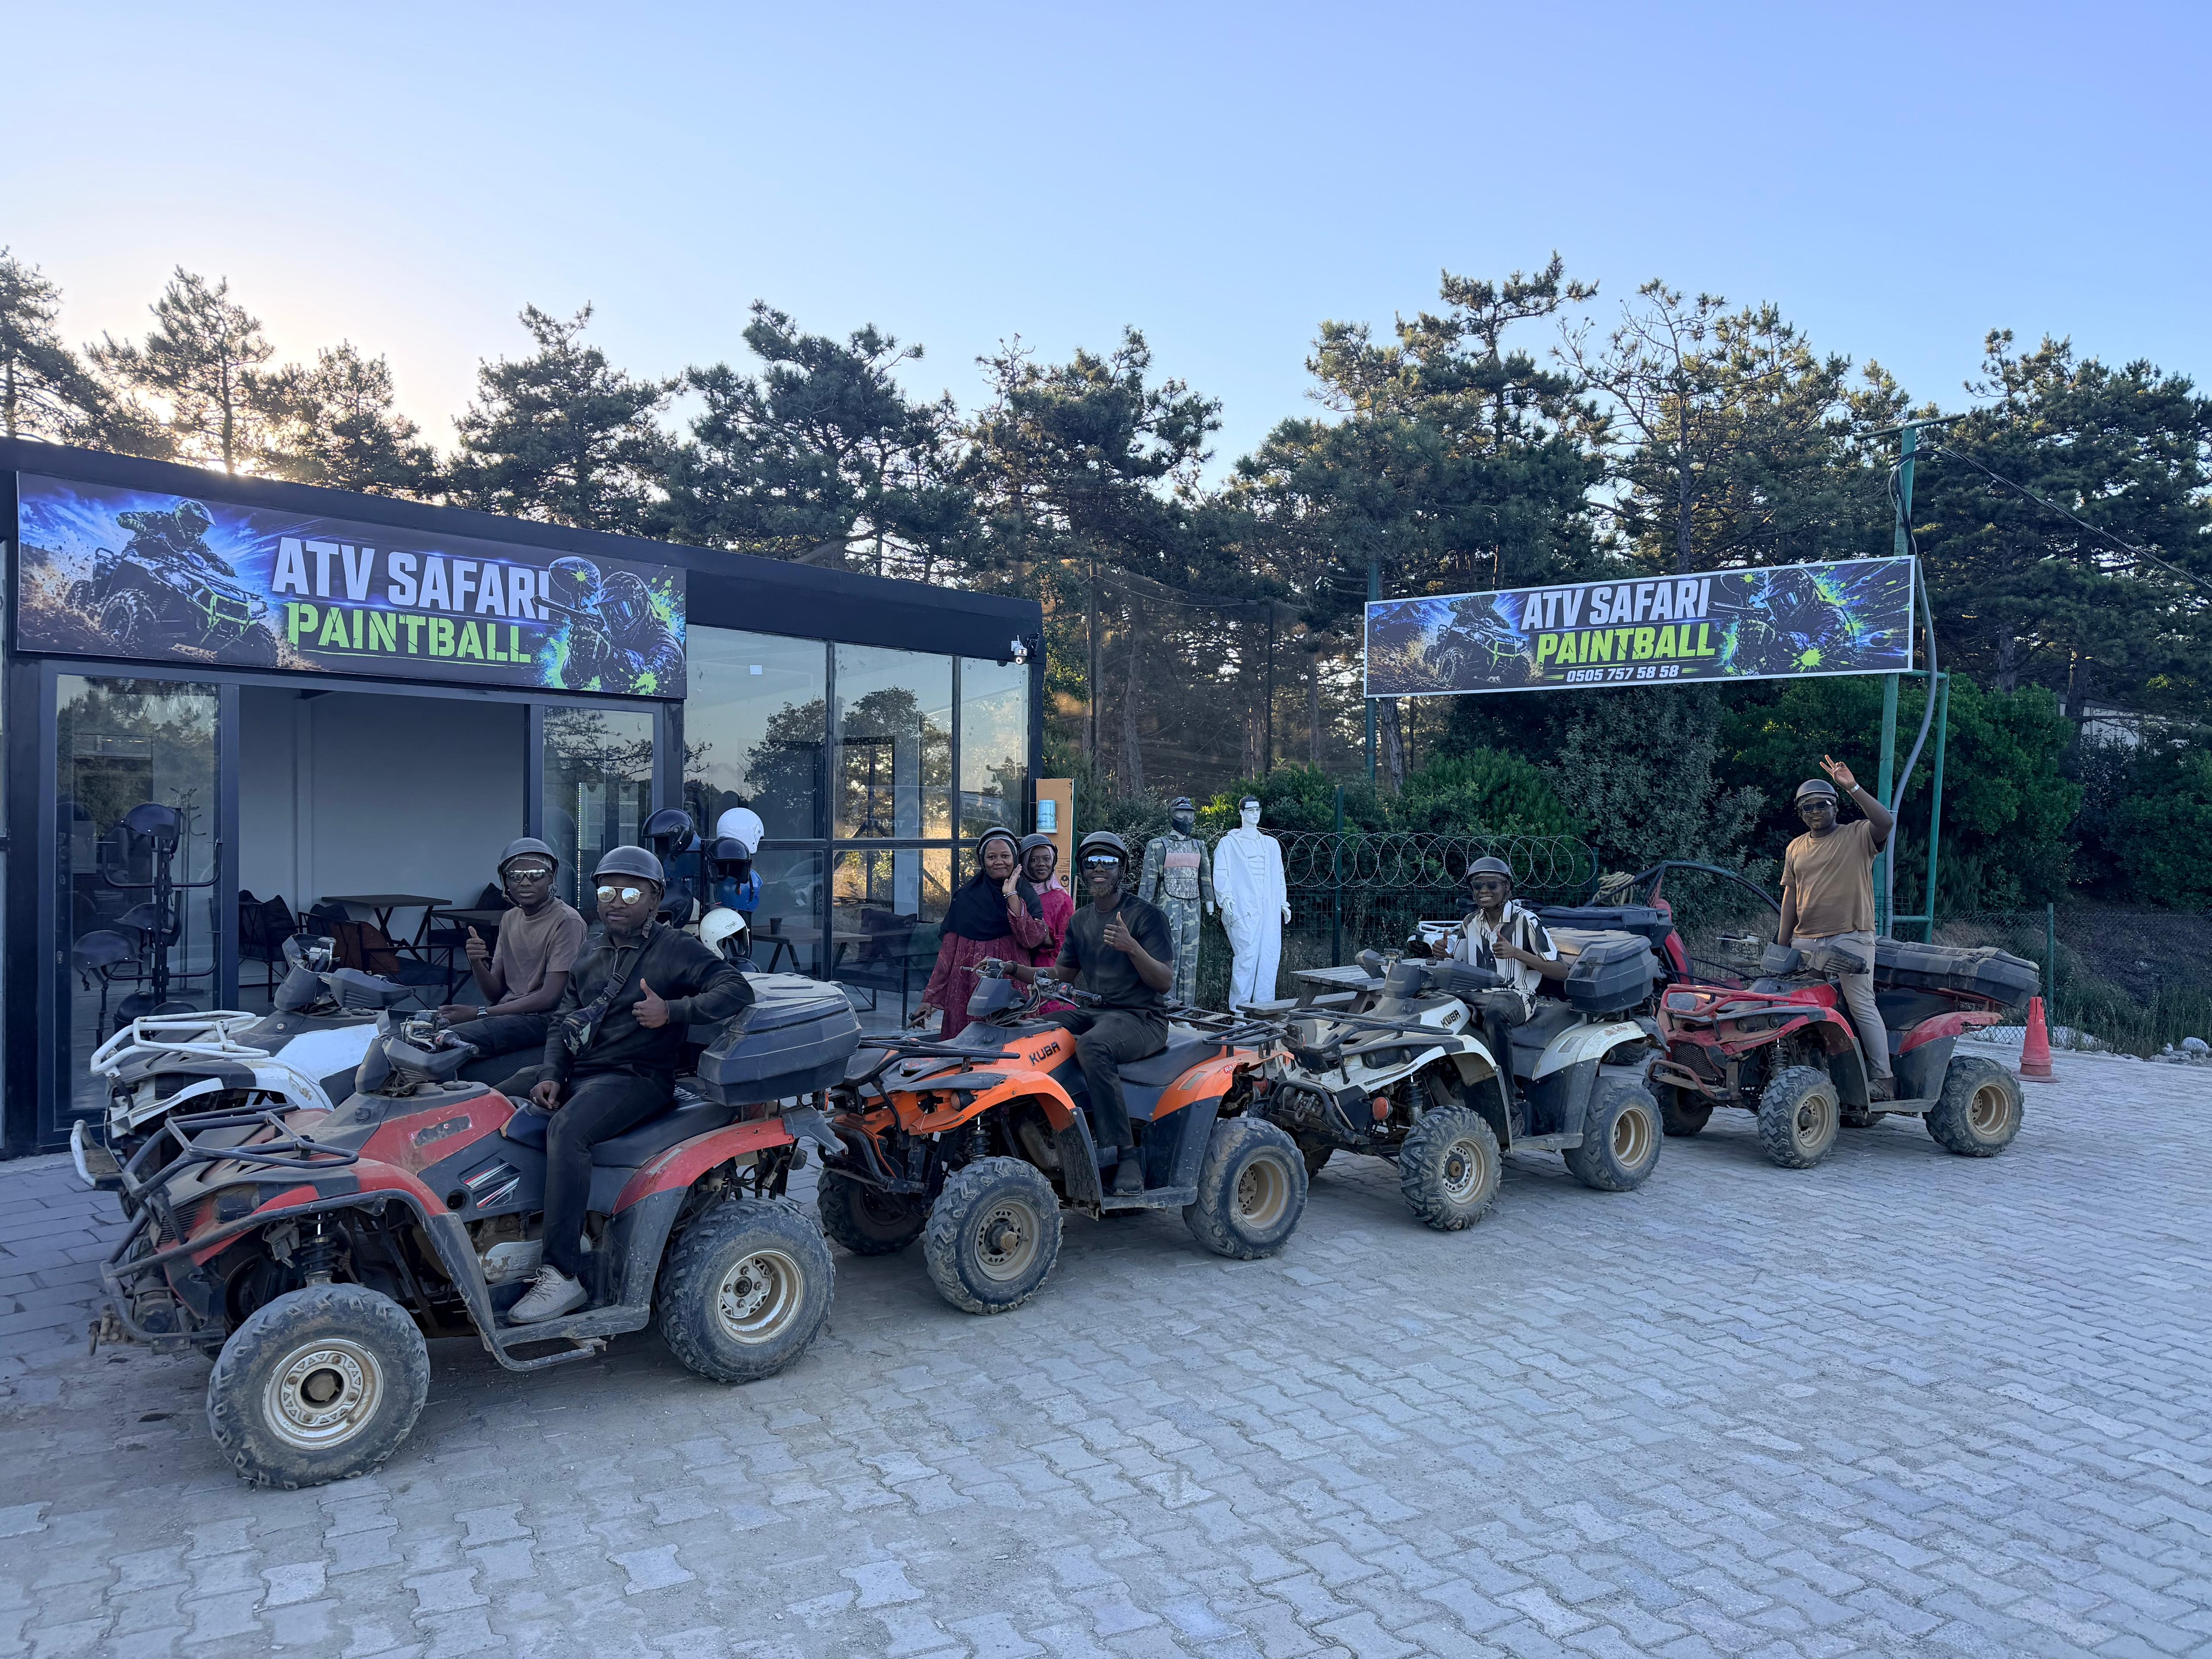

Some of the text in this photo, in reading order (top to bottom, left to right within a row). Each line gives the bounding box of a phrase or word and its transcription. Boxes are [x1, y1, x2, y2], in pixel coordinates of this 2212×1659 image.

[272, 537, 549, 620] ATV SAFARI
[1521, 578, 1711, 630] ATV SAFARI
[286, 602, 531, 664] PAINTBALL
[1536, 623, 1715, 667] PAINTBALL
[1566, 665, 1679, 683] 0505 757 58 58
[1440, 1009, 1461, 1028] KUBA
[1028, 1041, 1061, 1066] KUBA
